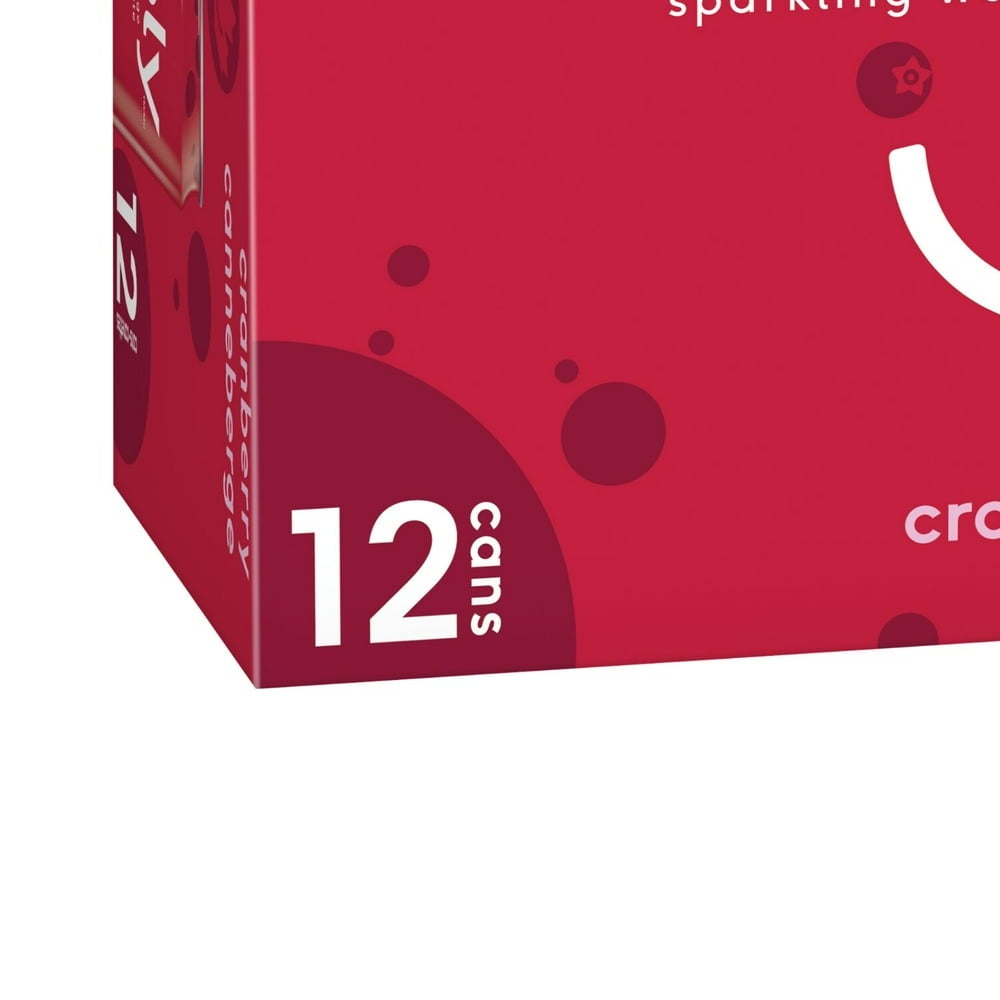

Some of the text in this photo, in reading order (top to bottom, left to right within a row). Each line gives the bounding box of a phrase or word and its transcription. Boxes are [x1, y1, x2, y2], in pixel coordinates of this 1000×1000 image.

[116, 190, 138, 321] 12
[222, 163, 238, 555] canneberge
[238, 248, 252, 581] cranberry
[291, 499, 502, 648] 12 cans
